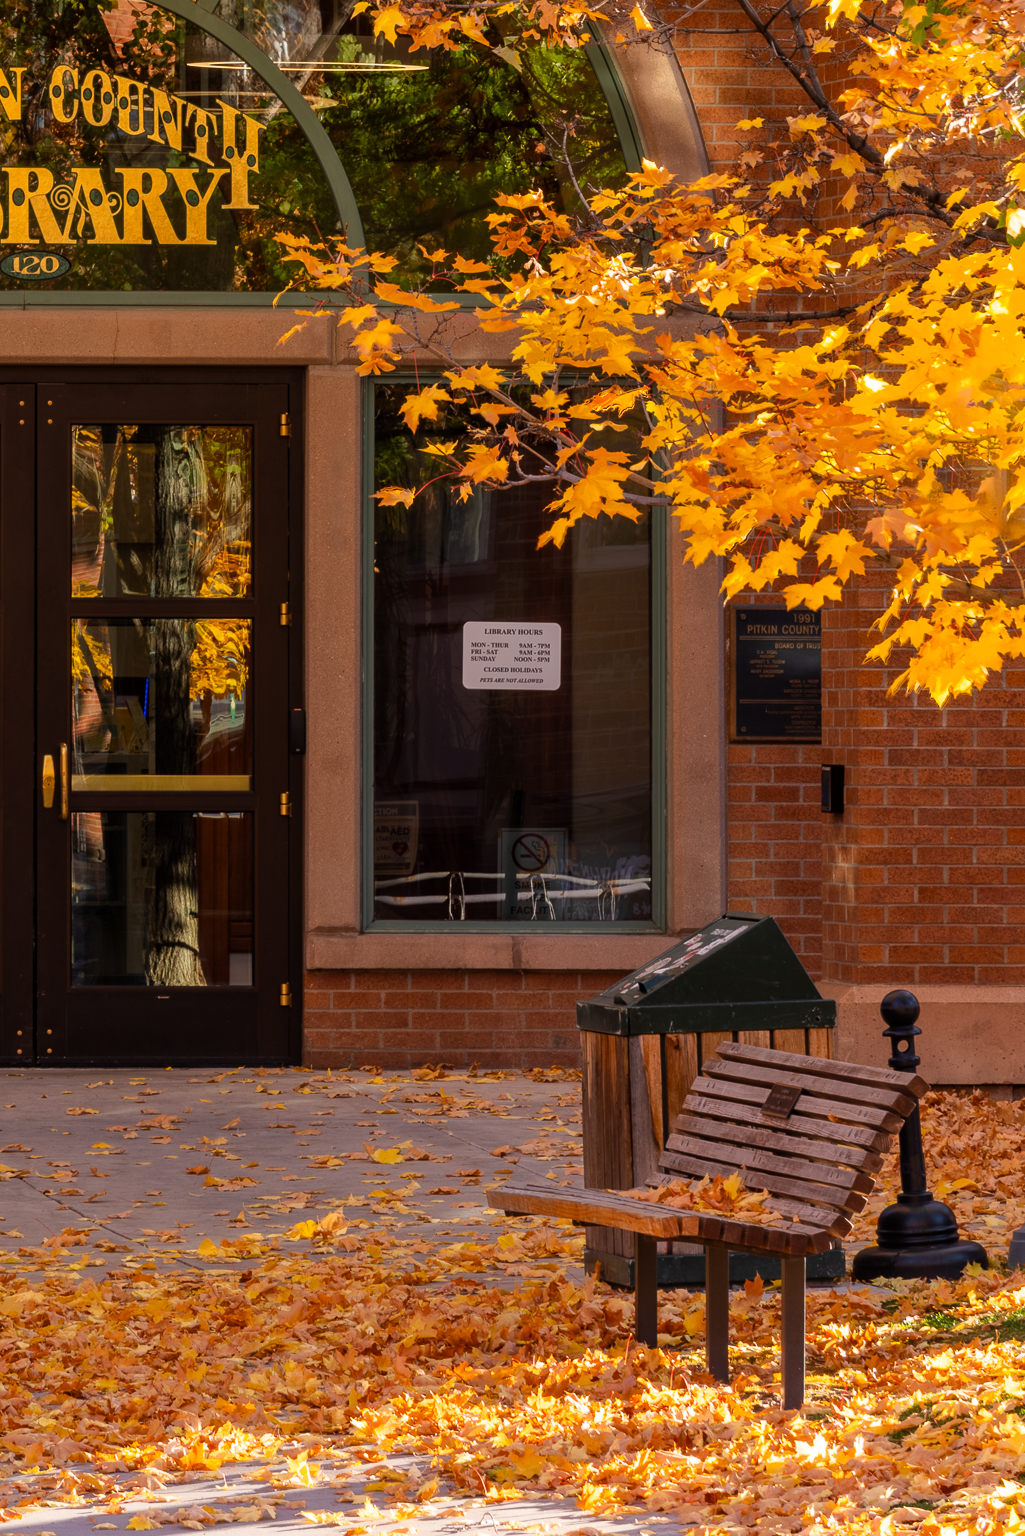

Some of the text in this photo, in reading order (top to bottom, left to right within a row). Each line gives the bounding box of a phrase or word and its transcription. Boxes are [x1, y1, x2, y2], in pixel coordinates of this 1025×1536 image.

[49, 65, 267, 210] COUNTY
[11, 256, 59, 275] 120
[793, 614, 815, 623] 1991
[747, 625, 819, 634] PITKIN COUNTY
[374, 807, 398, 816] CTION
[390, 827, 410, 836] AED
[514, 881, 551, 890] SMOKE
[510, 905, 551, 915] FACILIT
